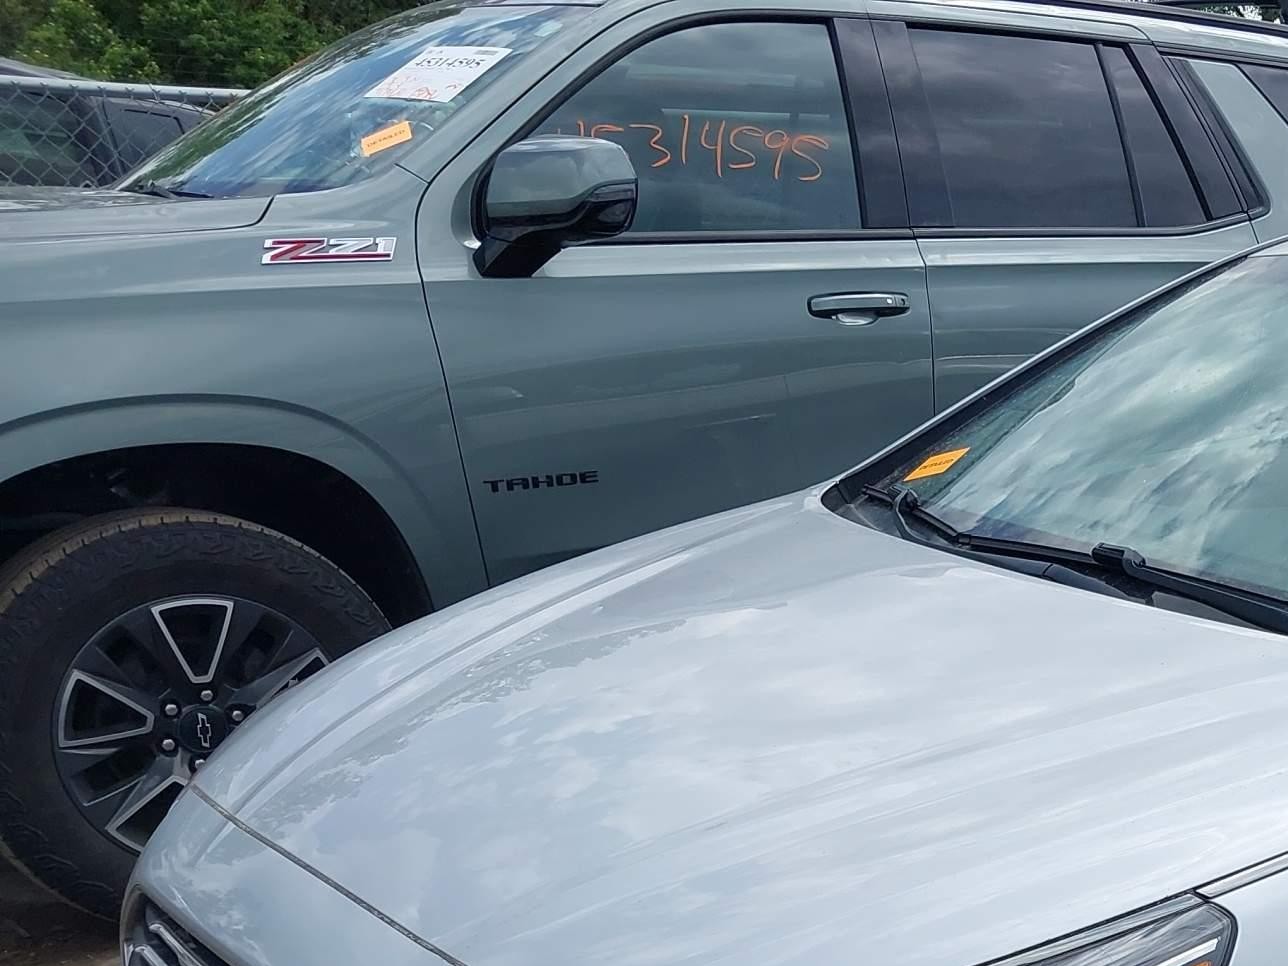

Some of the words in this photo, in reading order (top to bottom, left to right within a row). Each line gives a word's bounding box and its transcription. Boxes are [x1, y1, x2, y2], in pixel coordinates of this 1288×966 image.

[557, 114, 829, 181] 314595
[261, 237, 397, 264] Z71
[483, 470, 599, 493] TAHOE
